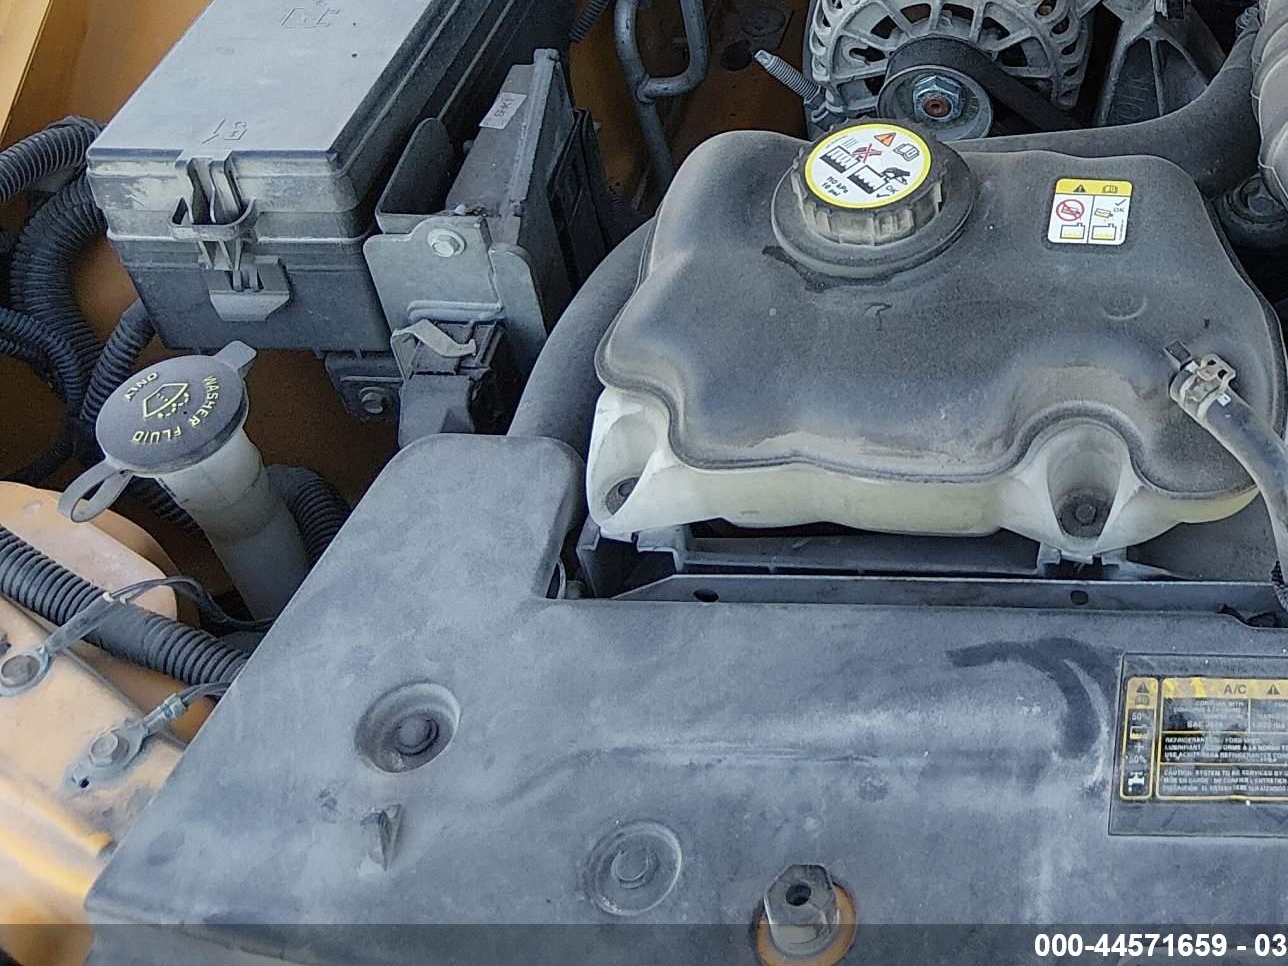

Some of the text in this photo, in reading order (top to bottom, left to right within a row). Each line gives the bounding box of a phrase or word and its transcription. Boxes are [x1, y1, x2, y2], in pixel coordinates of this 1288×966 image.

[886, 185, 900, 194] OK
[121, 371, 220, 444] WASHER FLUID ONLY
[1224, 684, 1247, 695] A/C
